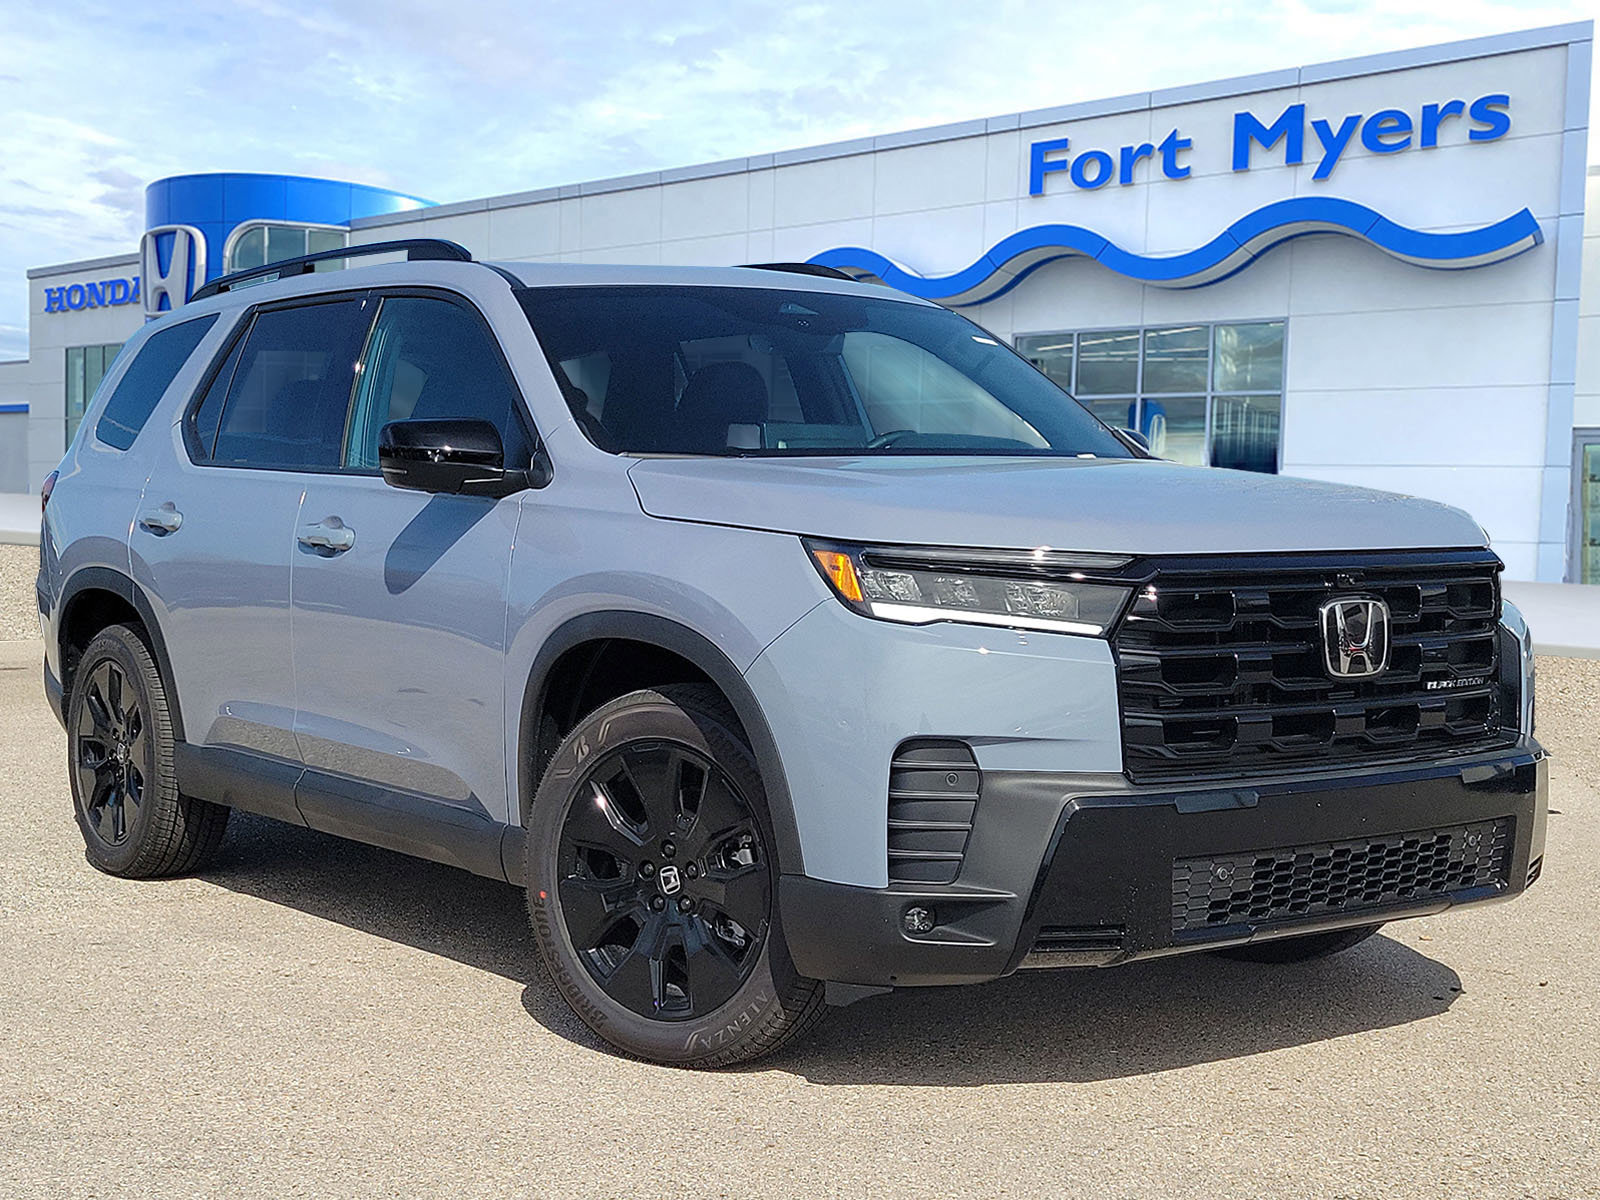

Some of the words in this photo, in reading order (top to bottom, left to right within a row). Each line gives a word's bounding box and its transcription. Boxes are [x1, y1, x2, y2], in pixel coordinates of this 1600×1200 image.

[1029, 127, 1193, 197] Fort
[1232, 94, 1513, 182] Myers
[701, 989, 768, 1049] ALENZA
